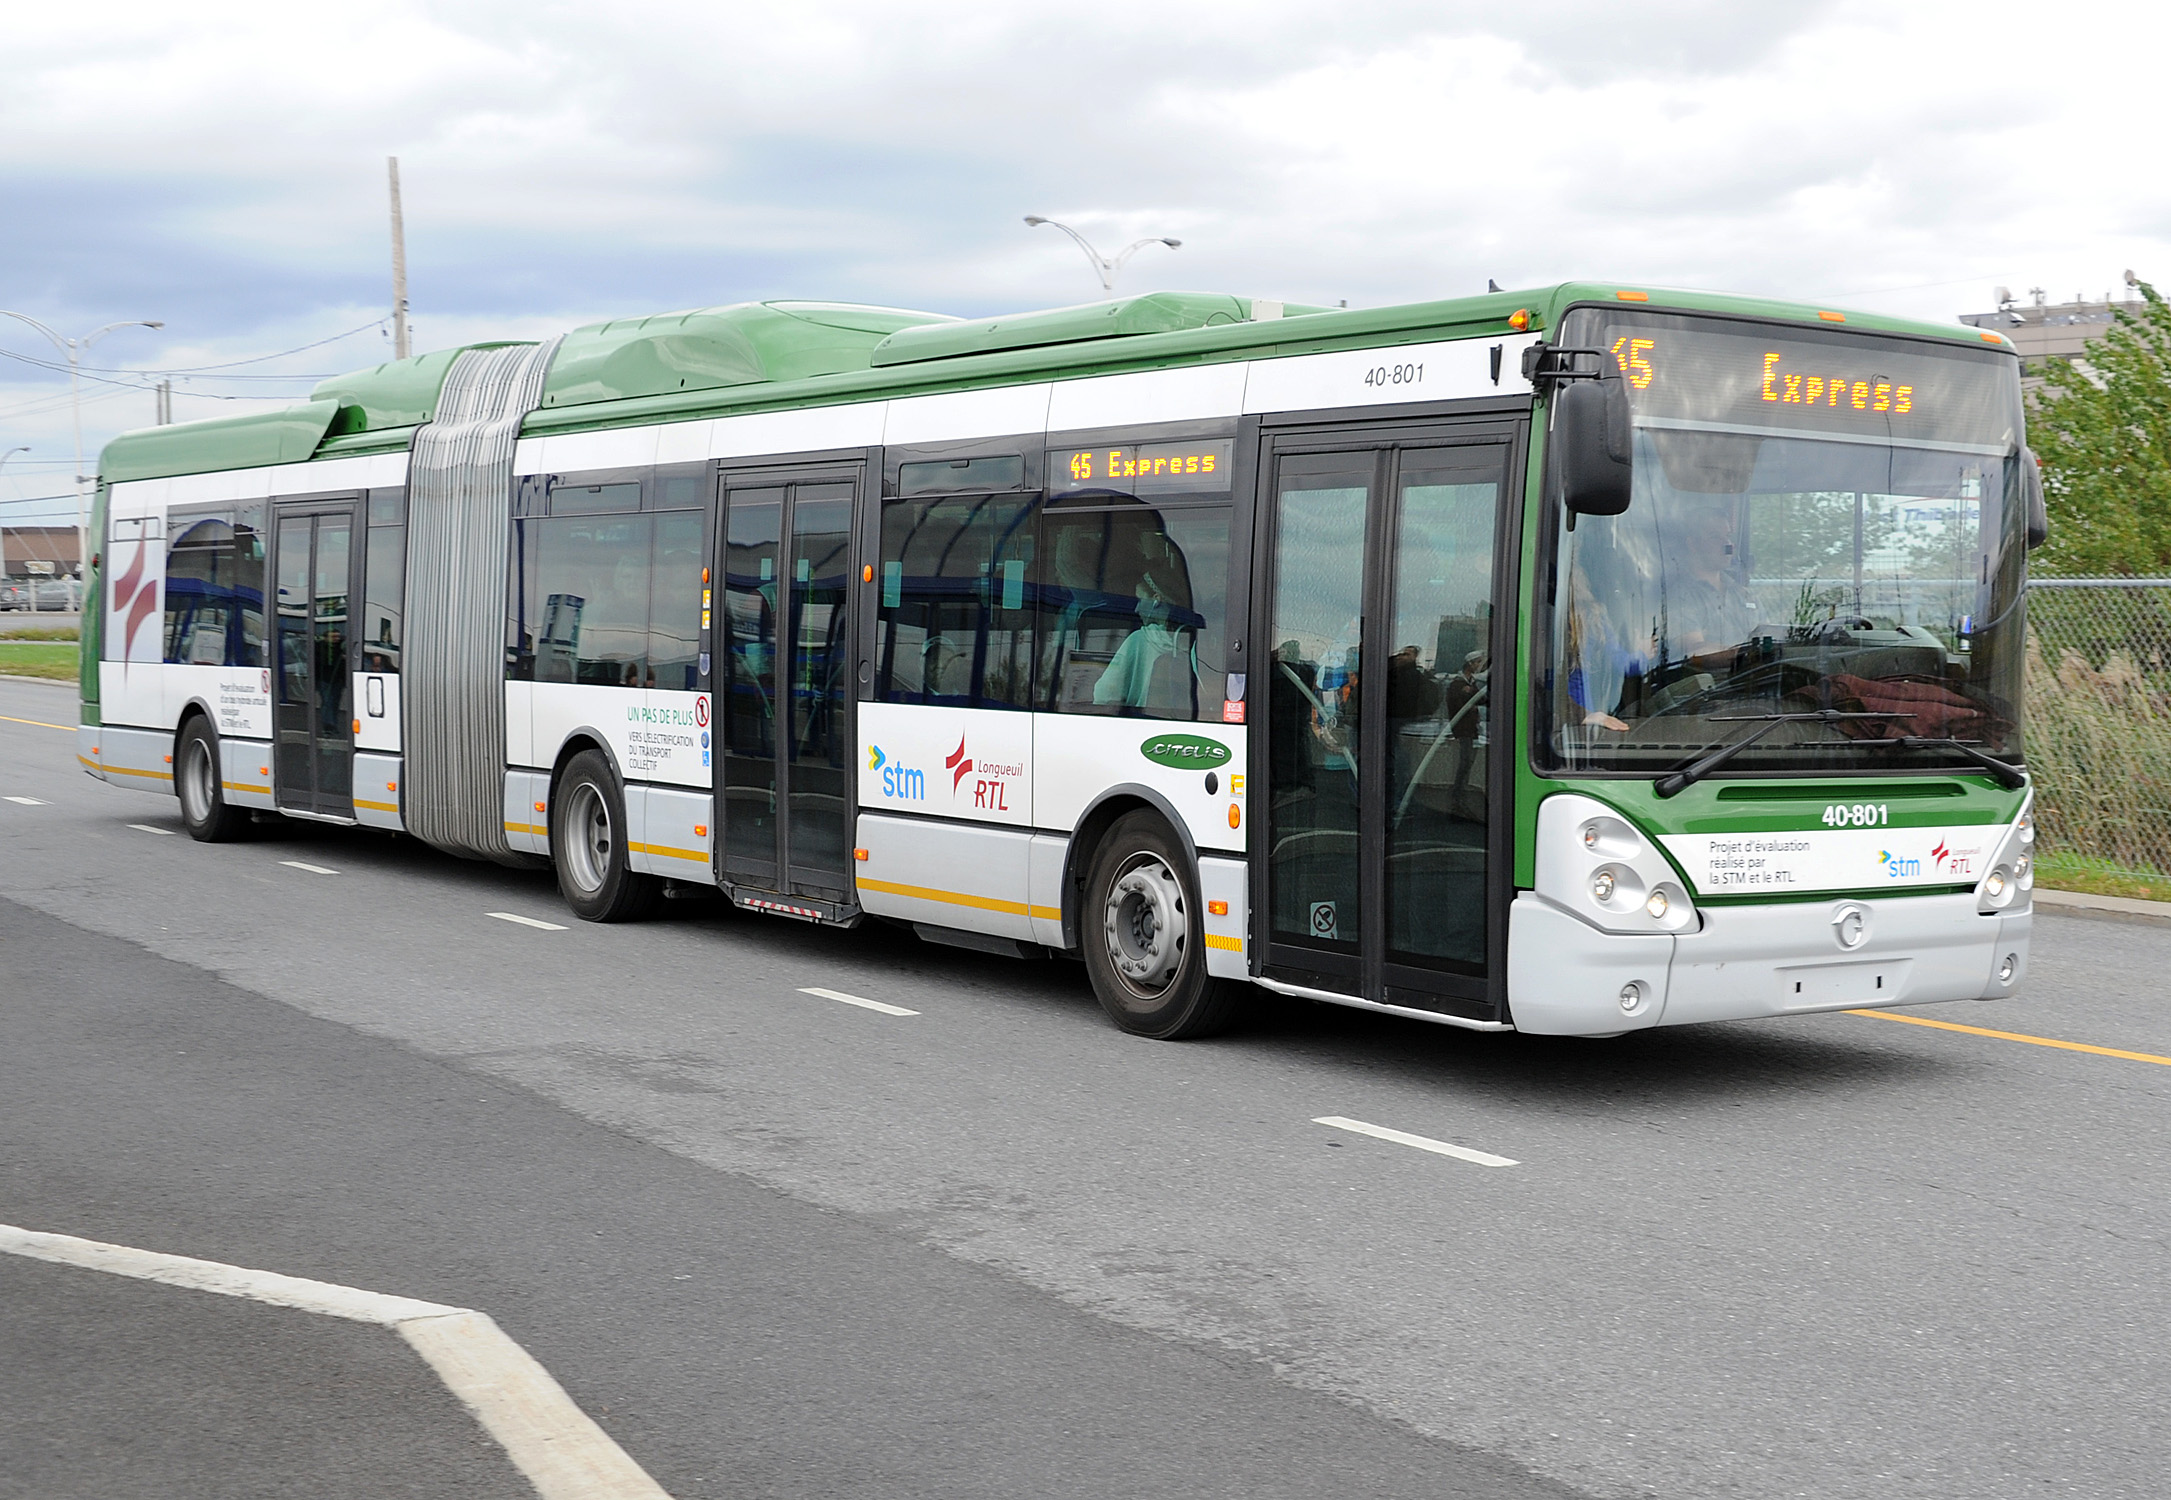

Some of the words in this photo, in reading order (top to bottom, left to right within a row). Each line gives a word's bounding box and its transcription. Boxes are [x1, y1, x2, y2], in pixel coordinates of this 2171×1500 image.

[1364, 363, 1424, 387] 40-801
[1762, 352, 1913, 413] Express
[1070, 453, 1092, 480] 45
[1108, 451, 1216, 478] Express
[627, 706, 640, 722] UN
[642, 707, 658, 724] PAS
[660, 708, 671, 725] DE
[673, 709, 694, 727] PLUS
[639, 745, 672, 759] TRANSPORT
[629, 758, 658, 771] COLLECTIF
[978, 760, 1024, 778] Longueuil
[883, 761, 925, 801] stm
[973, 780, 1009, 812] RTL
[1821, 804, 1888, 827] 40-801
[1709, 841, 1743, 856] Projet
[1744, 839, 1811, 853] d'évaluation
[1748, 858, 1766, 871] par
[1889, 857, 1920, 878] stm
[1950, 859, 1972, 875] RTL
[1709, 872, 1720, 885] la
[1722, 872, 1746, 885] STM
[1749, 872, 1761, 884] et
[1763, 871, 1772, 884] le
